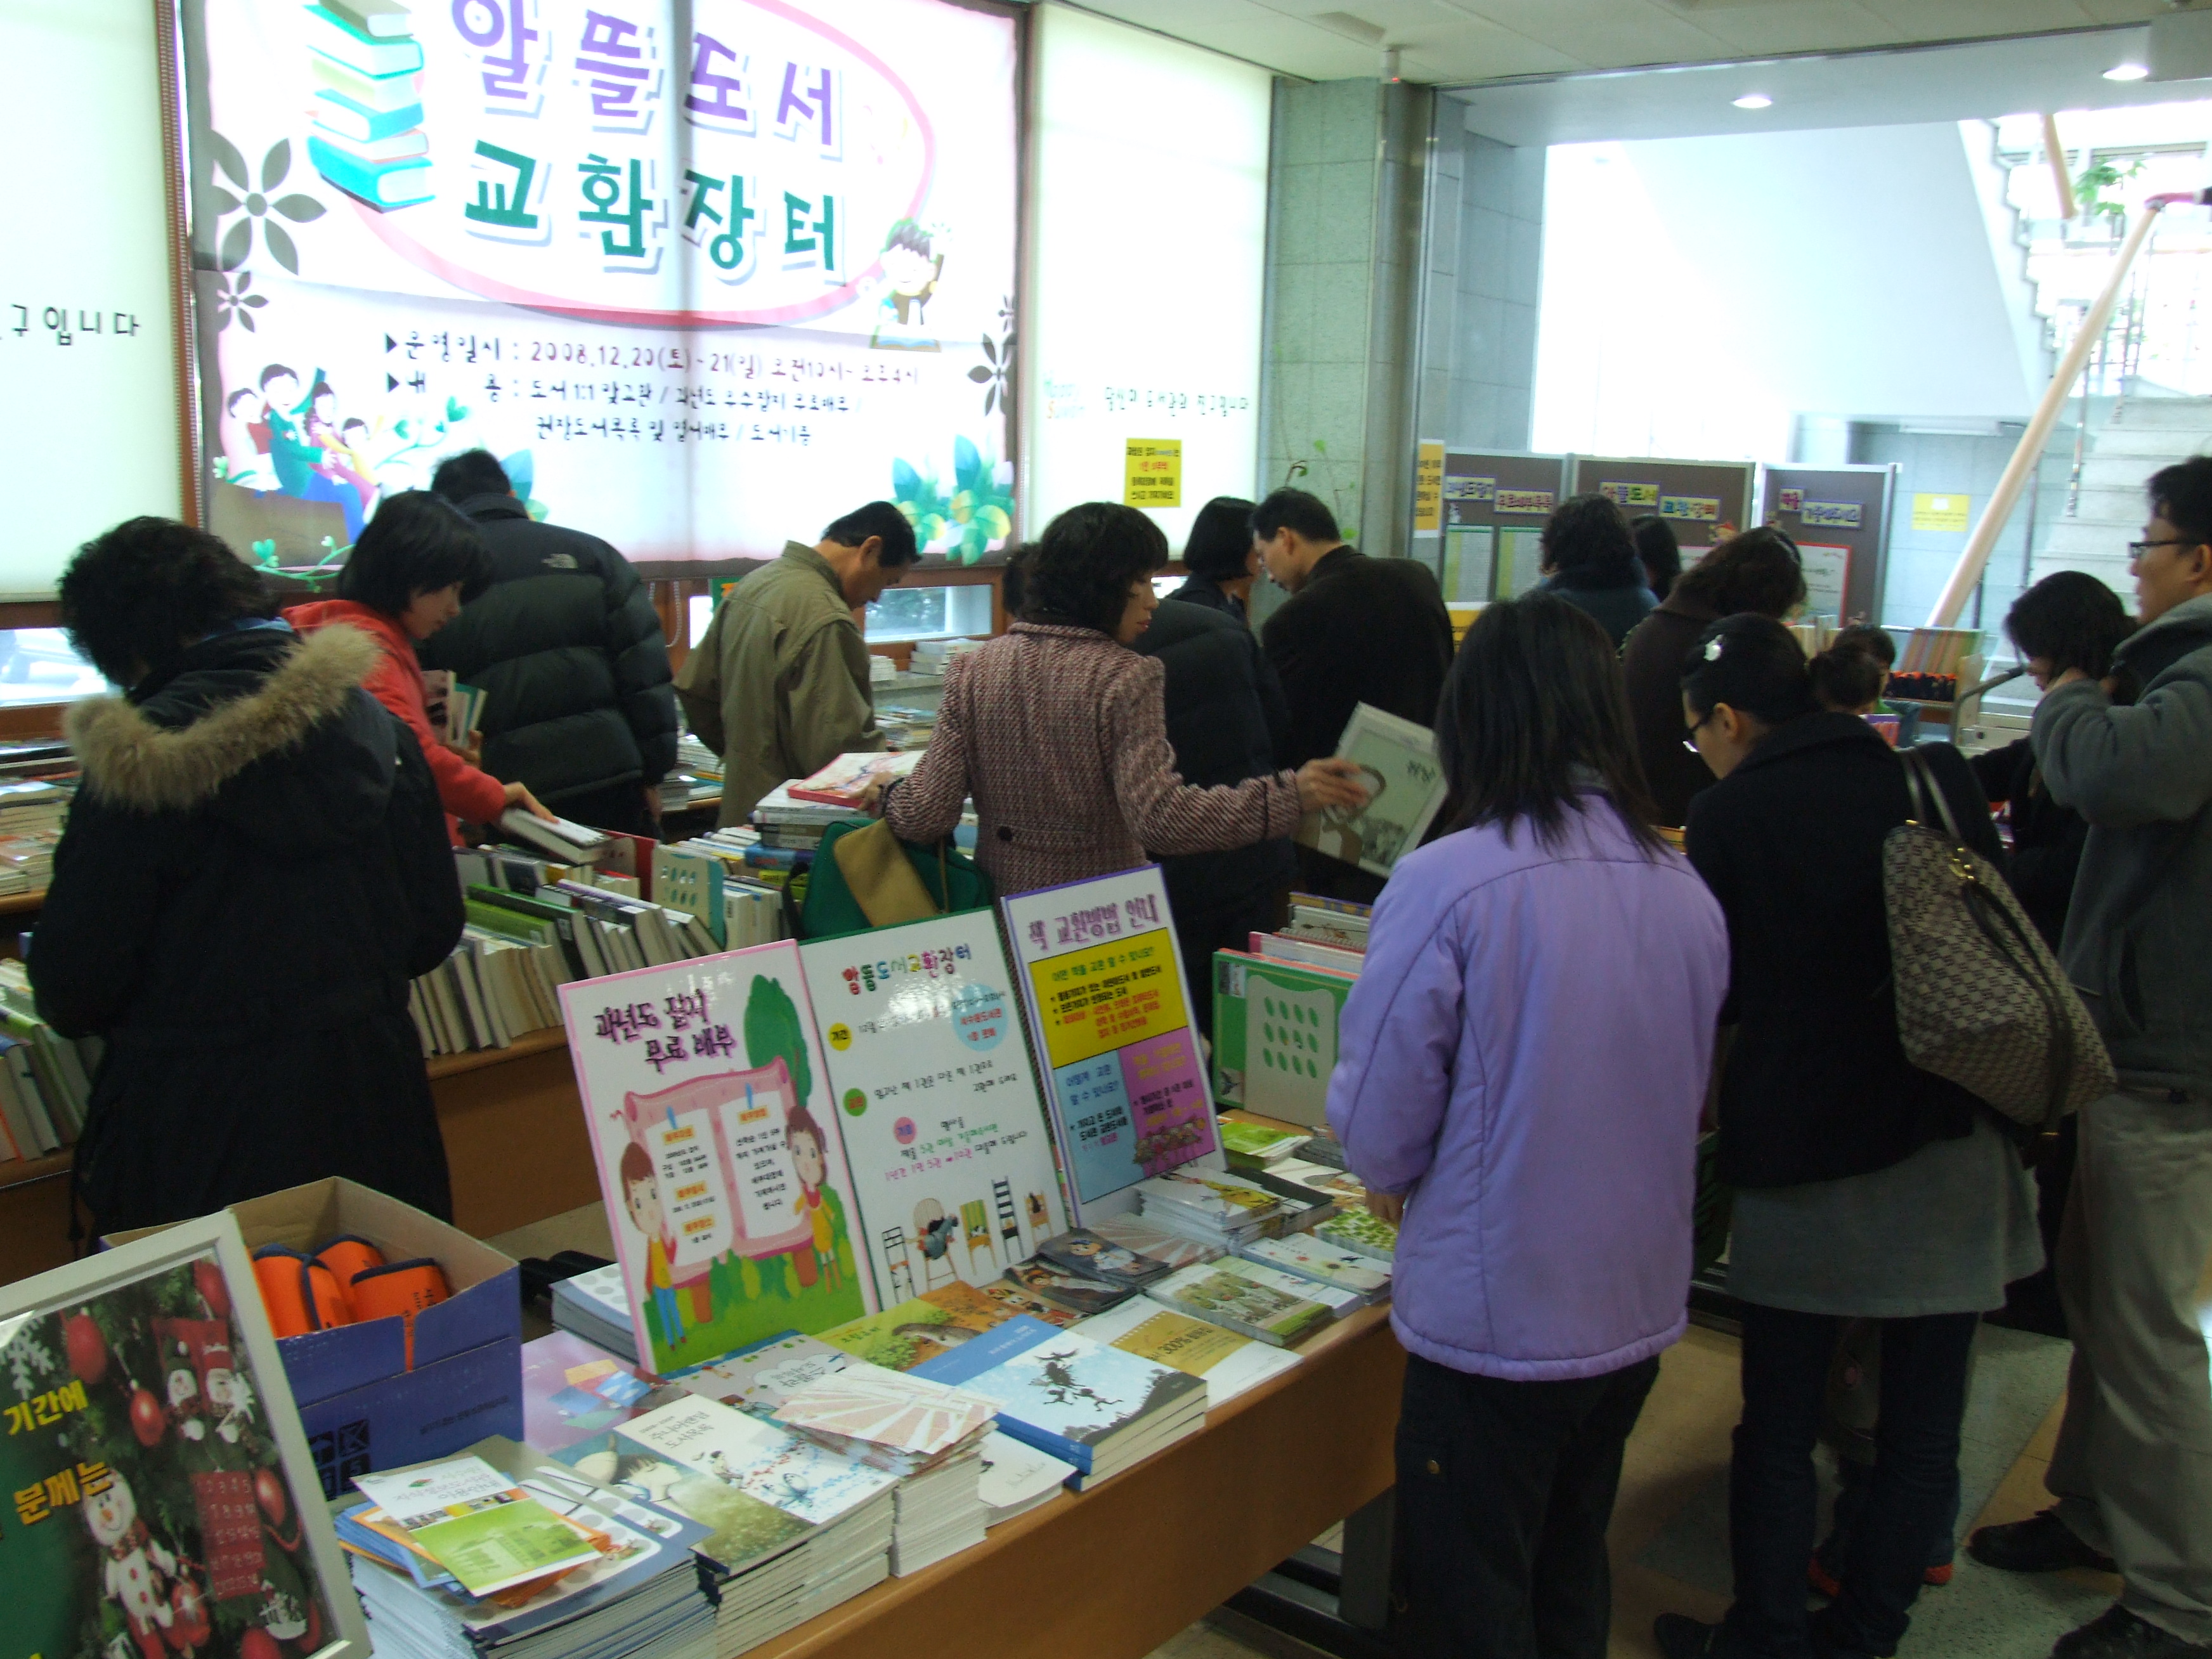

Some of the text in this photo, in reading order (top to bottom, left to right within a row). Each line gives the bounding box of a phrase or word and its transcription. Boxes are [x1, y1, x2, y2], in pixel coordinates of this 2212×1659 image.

[451, 0, 836, 150] 알뜰도서
[464, 138, 837, 274] 교환장터
[0, 303, 140, 346] 구입니다
[405, 331, 500, 362] 운영일시
[531, 380, 566, 401] 도서
[573, 383, 595, 401] 1:1
[602, 381, 652, 408] 맞교환
[536, 414, 641, 441] 권장도서목록
[1055, 902, 1122, 946] 교환방법
[594, 988, 710, 1045] 과년도 잡지
[644, 1024, 738, 1075] 무료 배부
[3, 1379, 89, 1436] 기간에
